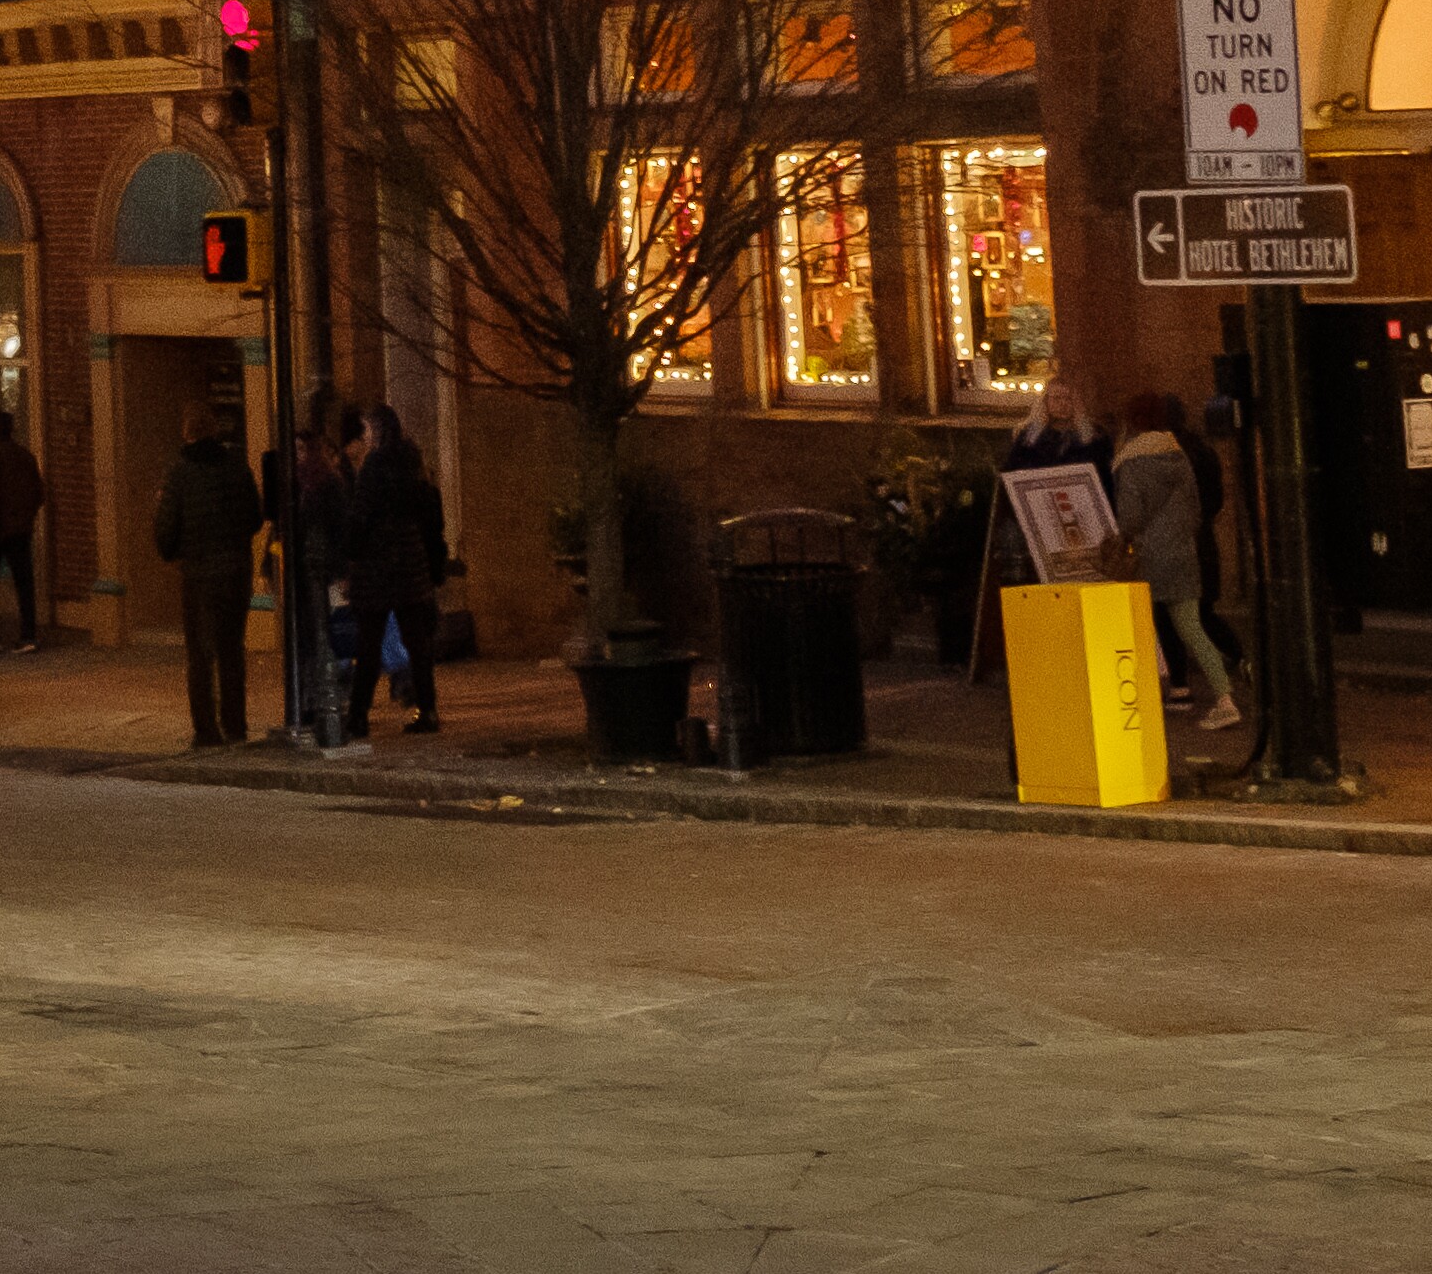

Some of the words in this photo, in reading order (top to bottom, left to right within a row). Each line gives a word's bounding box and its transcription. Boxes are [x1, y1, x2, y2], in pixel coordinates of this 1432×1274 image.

[1206, 33, 1273, 59] TURN
[1194, 70, 1226, 94] ON
[1241, 68, 1289, 93] RED
[1225, 197, 1304, 231] HISTORIC
[1188, 239, 1243, 272] HOTEL
[1248, 238, 1348, 272] BETHLEHEM
[1114, 649, 1141, 731] ICON
